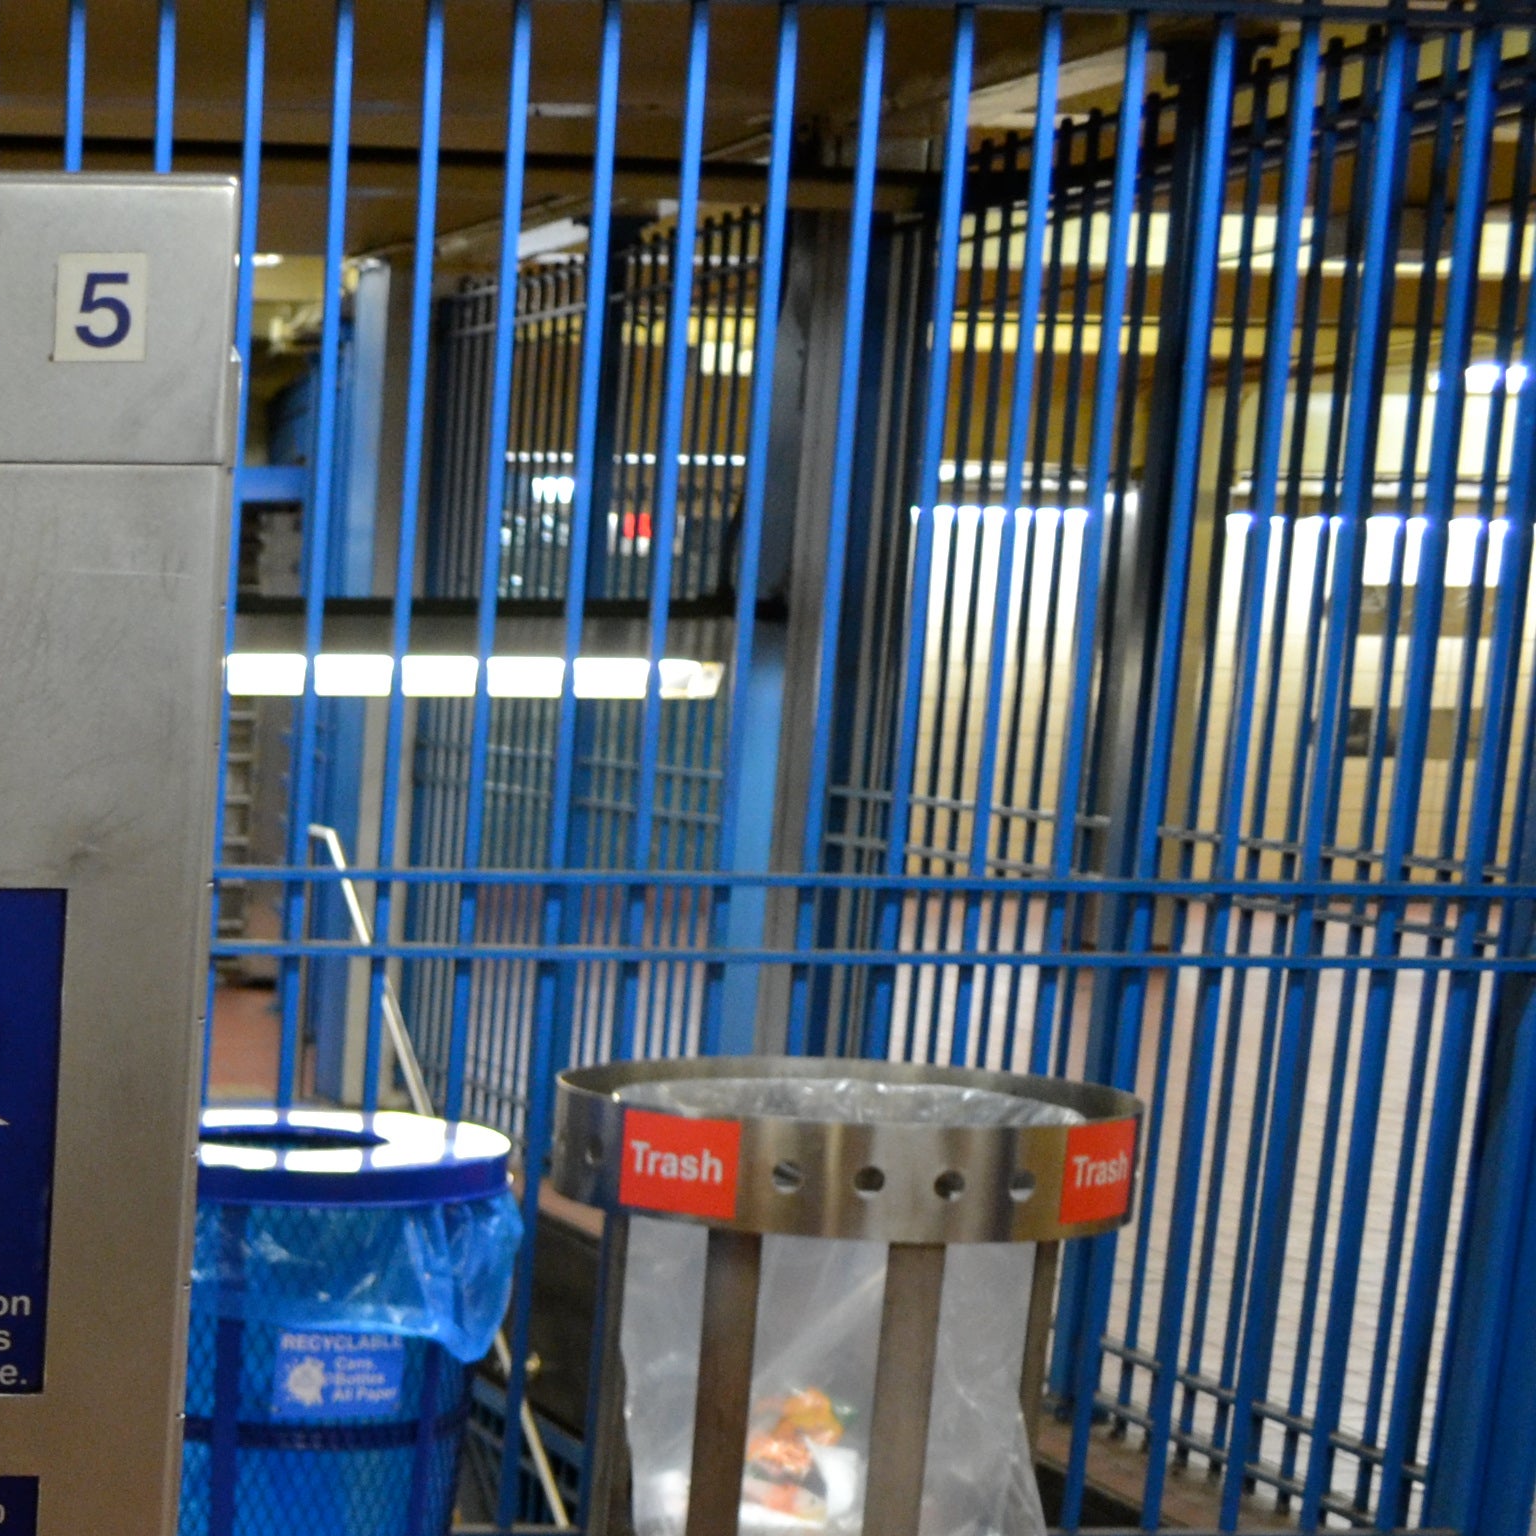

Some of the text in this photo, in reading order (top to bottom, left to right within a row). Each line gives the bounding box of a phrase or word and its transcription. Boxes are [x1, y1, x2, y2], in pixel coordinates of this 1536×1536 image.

[75, 273, 131, 348] 5
[631, 1140, 722, 1183] Trash
[1073, 1151, 1128, 1187] Trash
